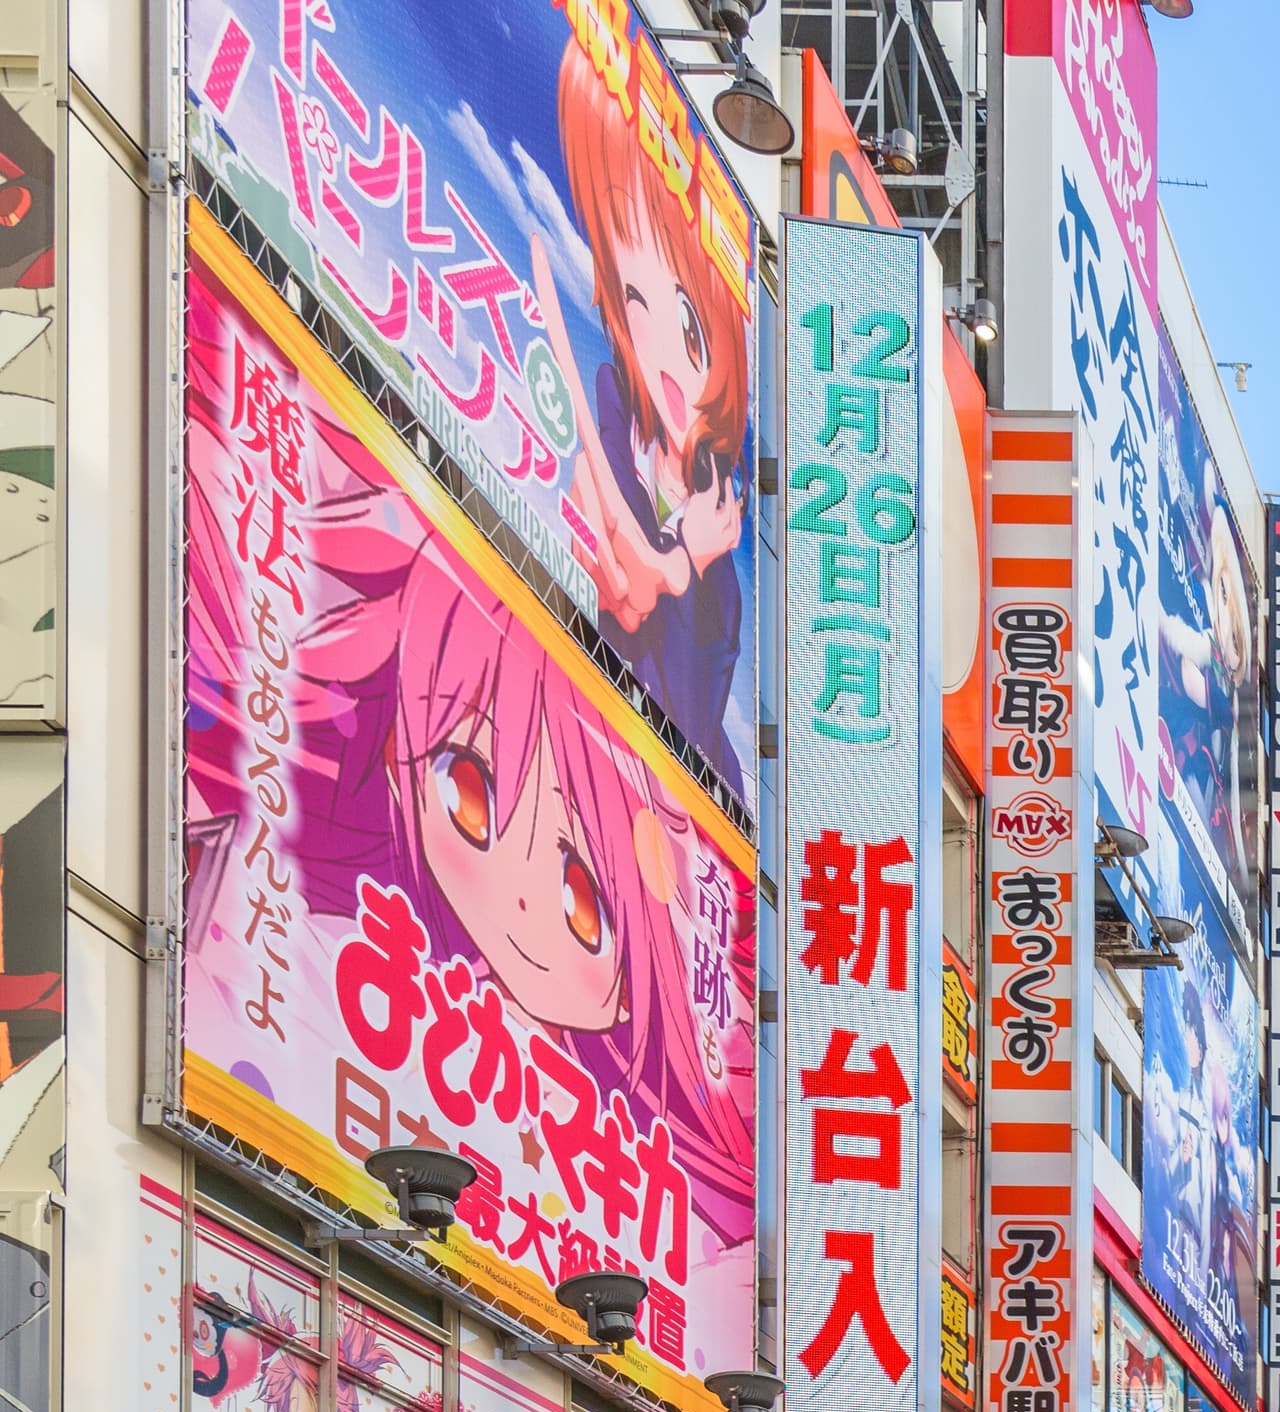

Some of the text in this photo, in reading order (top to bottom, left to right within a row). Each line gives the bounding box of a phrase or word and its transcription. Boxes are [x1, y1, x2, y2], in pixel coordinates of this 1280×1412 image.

[231, 333, 304, 1044] 魔法もあるんだよ
[997, 607, 1065, 780] 買取り
[692, 855, 733, 1081] 奇跡も
[997, 870, 1061, 1074] まっくす
